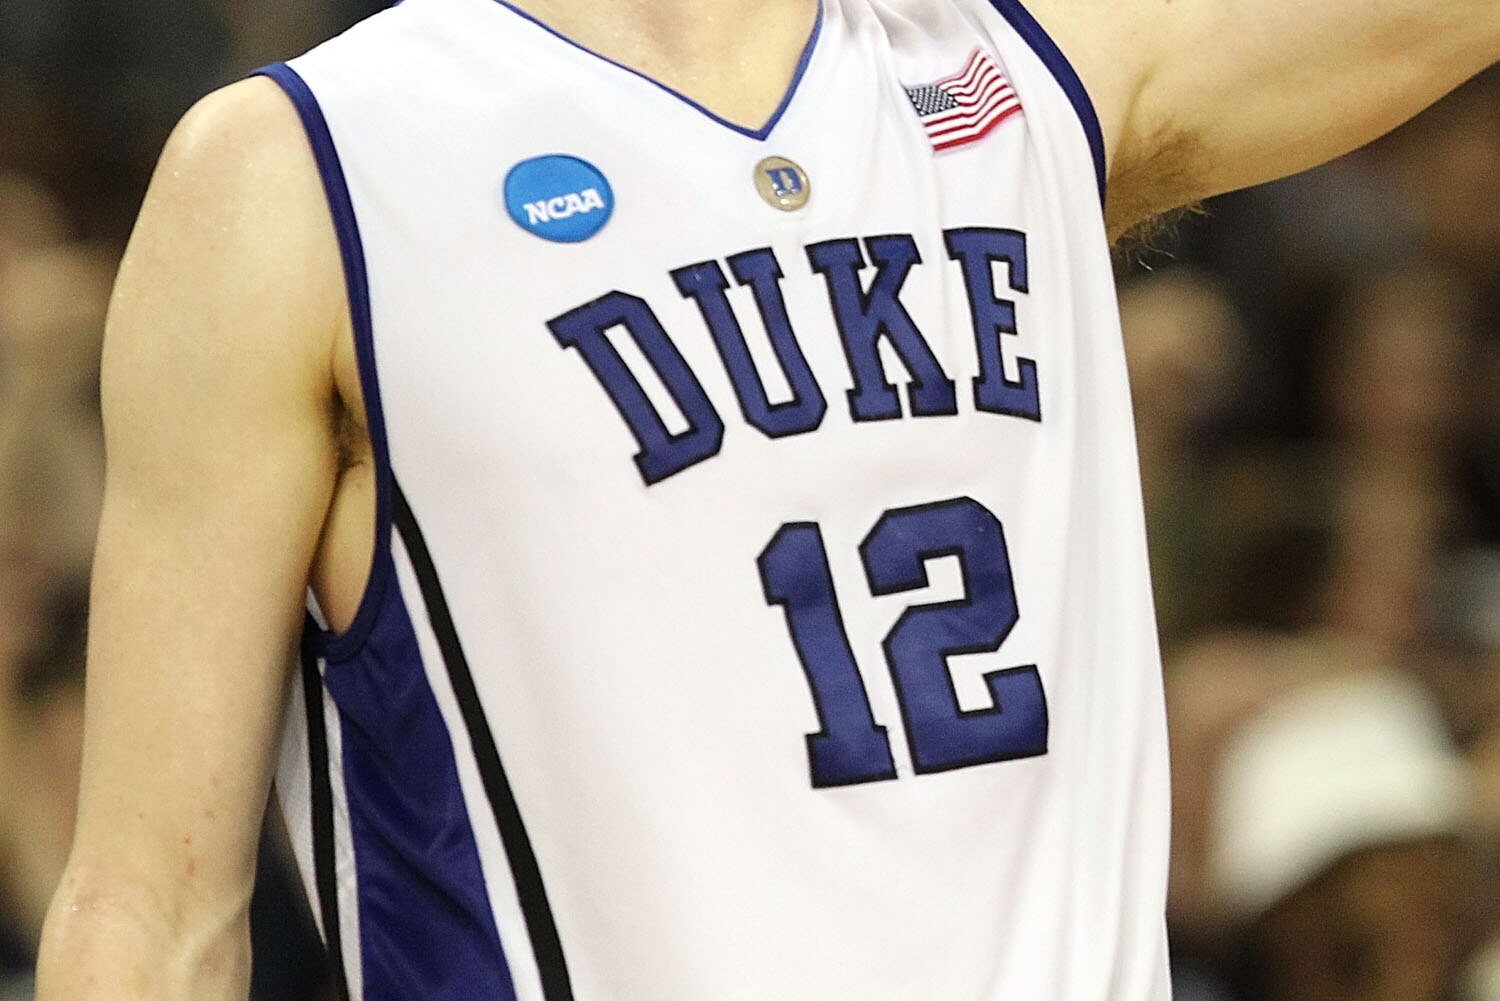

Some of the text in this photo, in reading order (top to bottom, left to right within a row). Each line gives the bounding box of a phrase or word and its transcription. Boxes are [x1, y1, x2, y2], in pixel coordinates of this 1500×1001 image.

[523, 188, 604, 225] NCAA
[767, 167, 801, 197] D
[545, 227, 1041, 487] DUKE
[756, 496, 1049, 788] 12
